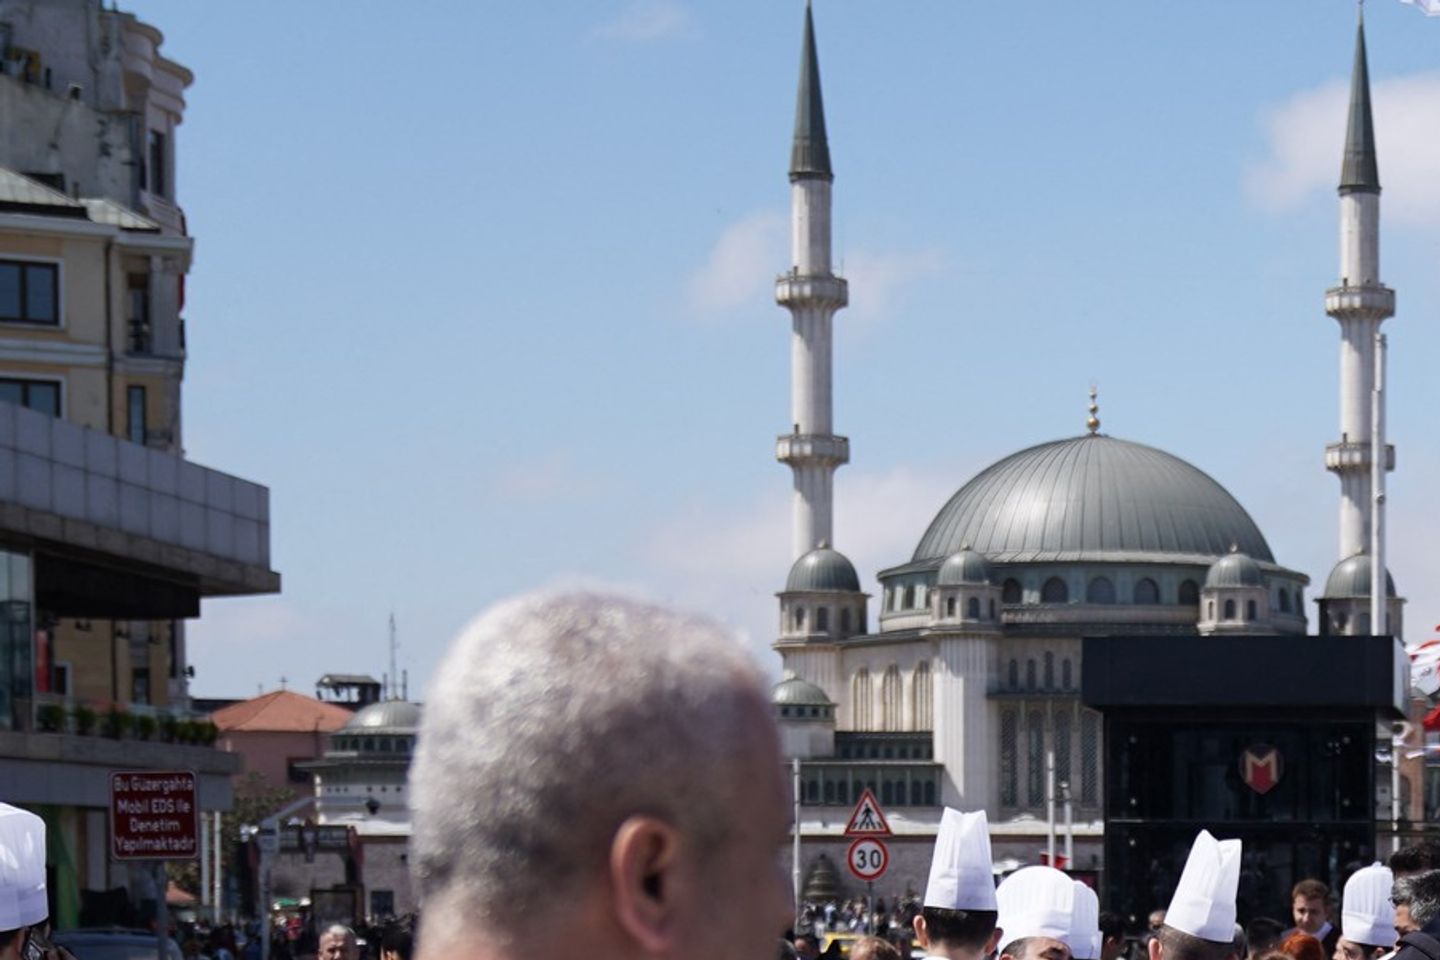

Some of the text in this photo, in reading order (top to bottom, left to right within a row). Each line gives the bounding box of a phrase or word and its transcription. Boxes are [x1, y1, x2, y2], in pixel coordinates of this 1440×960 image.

[114, 776, 129, 791] Bu
[117, 799, 149, 813] Mobil
[152, 798, 175, 813] EDS
[129, 817, 181, 832] Denetim
[856, 850, 881, 869] 30
